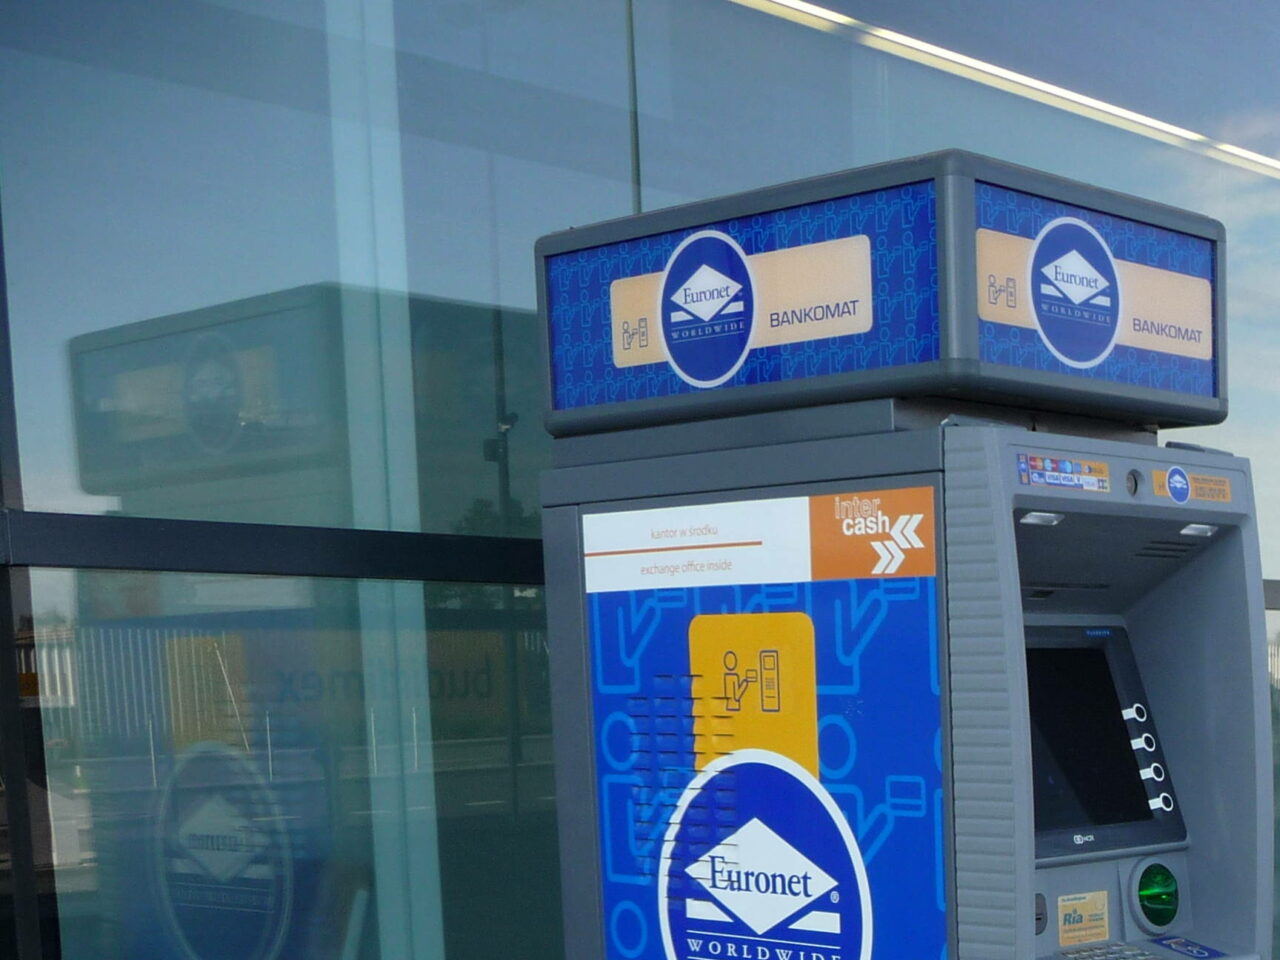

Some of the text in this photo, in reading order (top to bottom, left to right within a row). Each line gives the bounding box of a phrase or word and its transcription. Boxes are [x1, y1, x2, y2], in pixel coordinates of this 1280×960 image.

[1054, 265, 1098, 289] Euronet
[683, 286, 731, 304] Euronet
[770, 300, 859, 328] BANKOMAT
[1041, 303, 1111, 324] WORLDWIDE
[671, 322, 745, 339] WORLDWIDE
[1132, 318, 1202, 343] BANKOMAT
[834, 496, 881, 519] inter
[651, 528, 677, 539] kantor
[842, 510, 890, 535] cash
[640, 558, 732, 576] exchange office inside
[709, 855, 813, 897] Euronet
[1063, 912, 1083, 926] Ria
